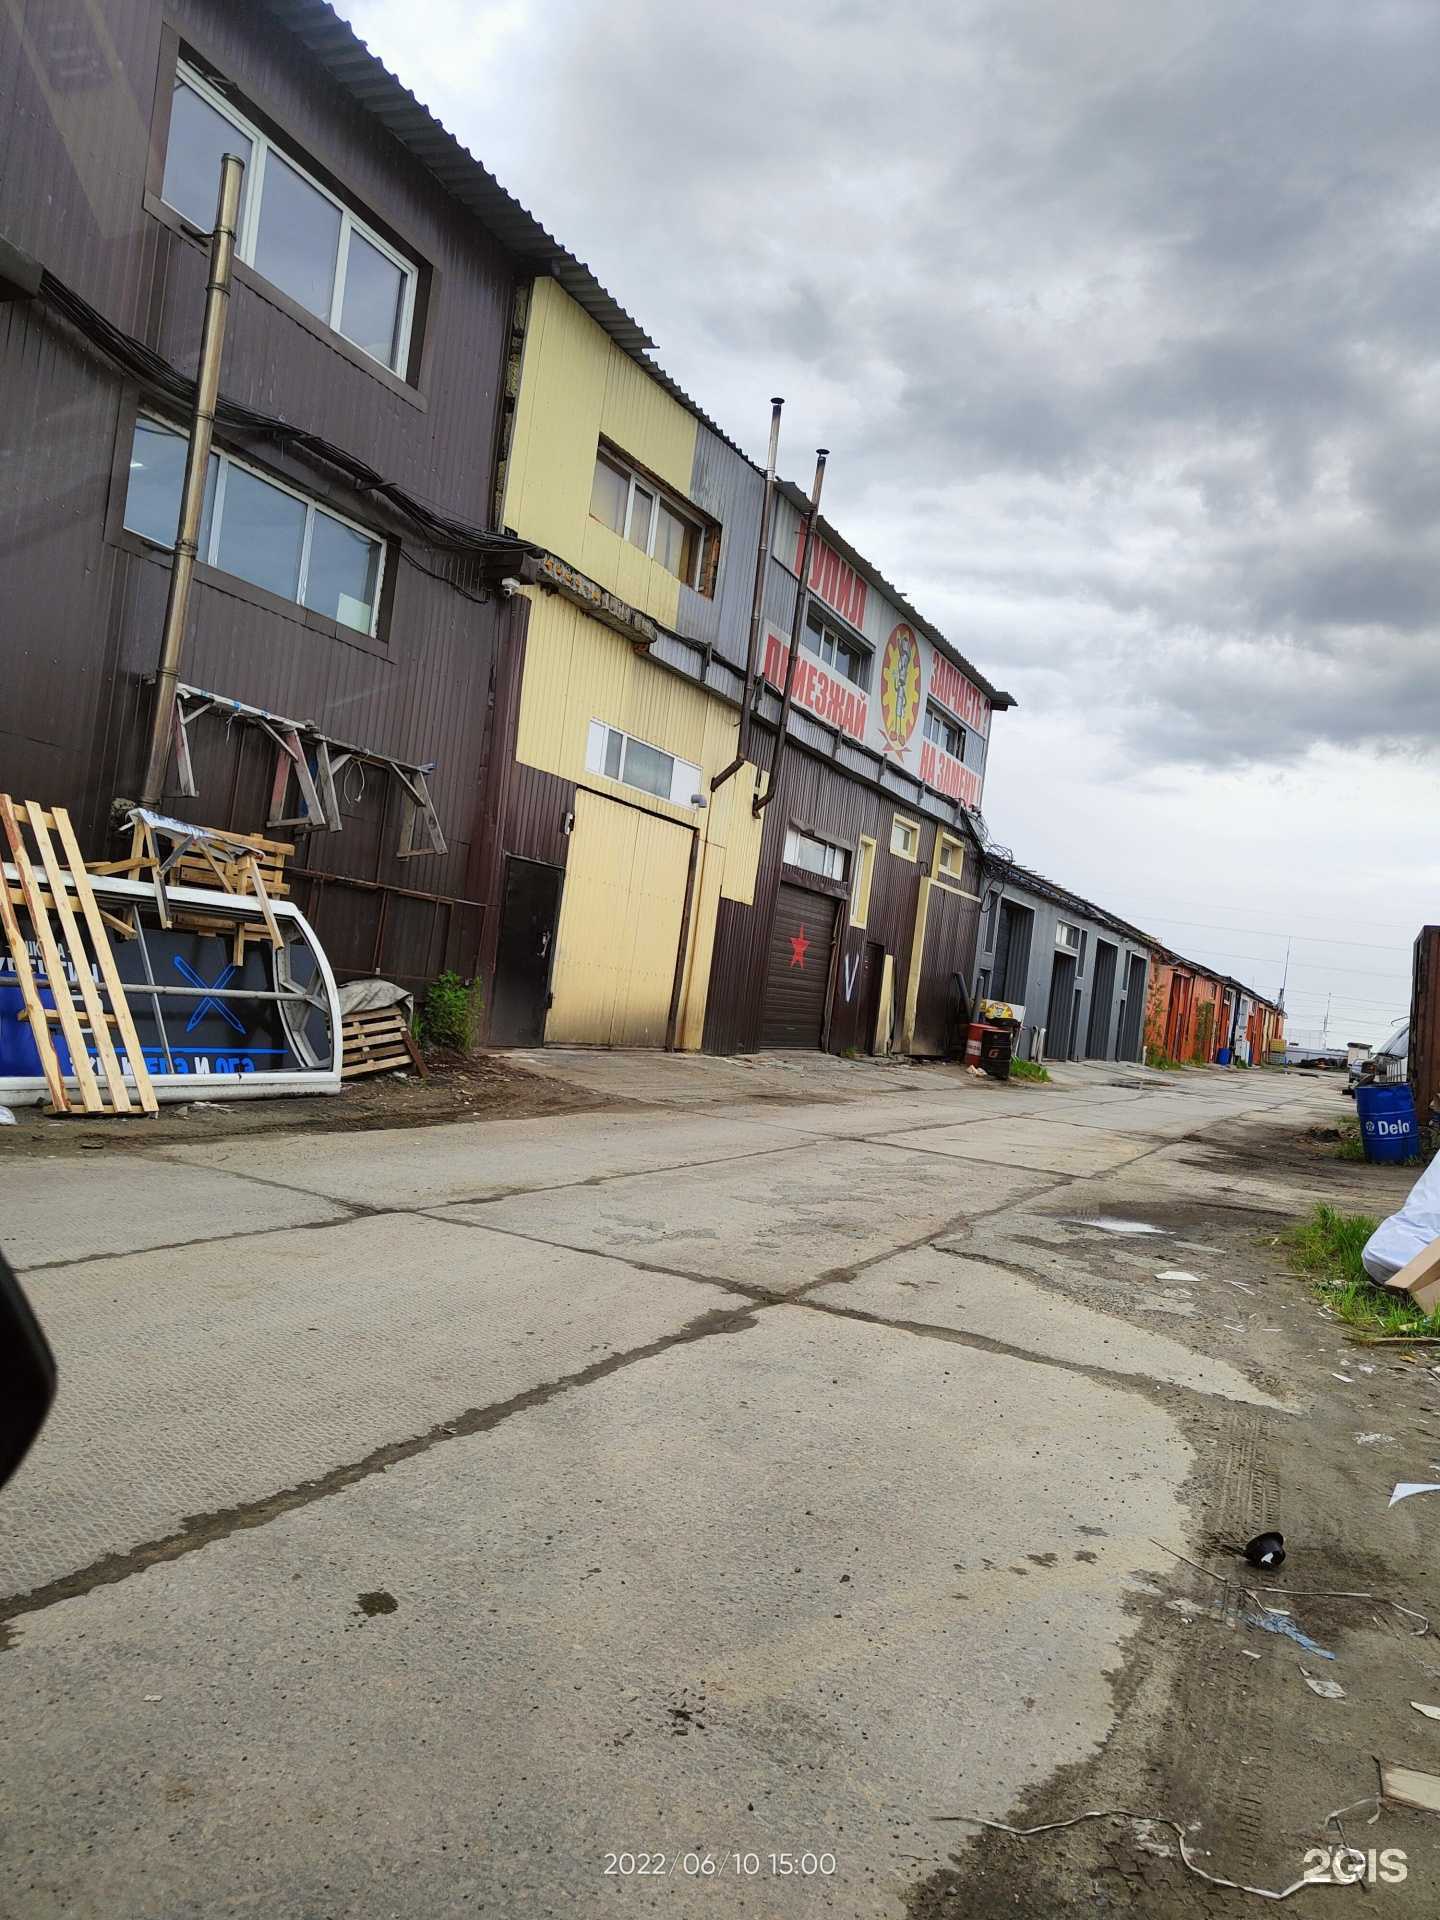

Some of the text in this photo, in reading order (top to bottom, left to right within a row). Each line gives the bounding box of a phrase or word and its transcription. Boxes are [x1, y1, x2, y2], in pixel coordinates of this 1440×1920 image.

[919, 740, 936, 784] НА
[845, 952, 859, 1003] V
[1377, 1119, 1410, 1136] Delo
